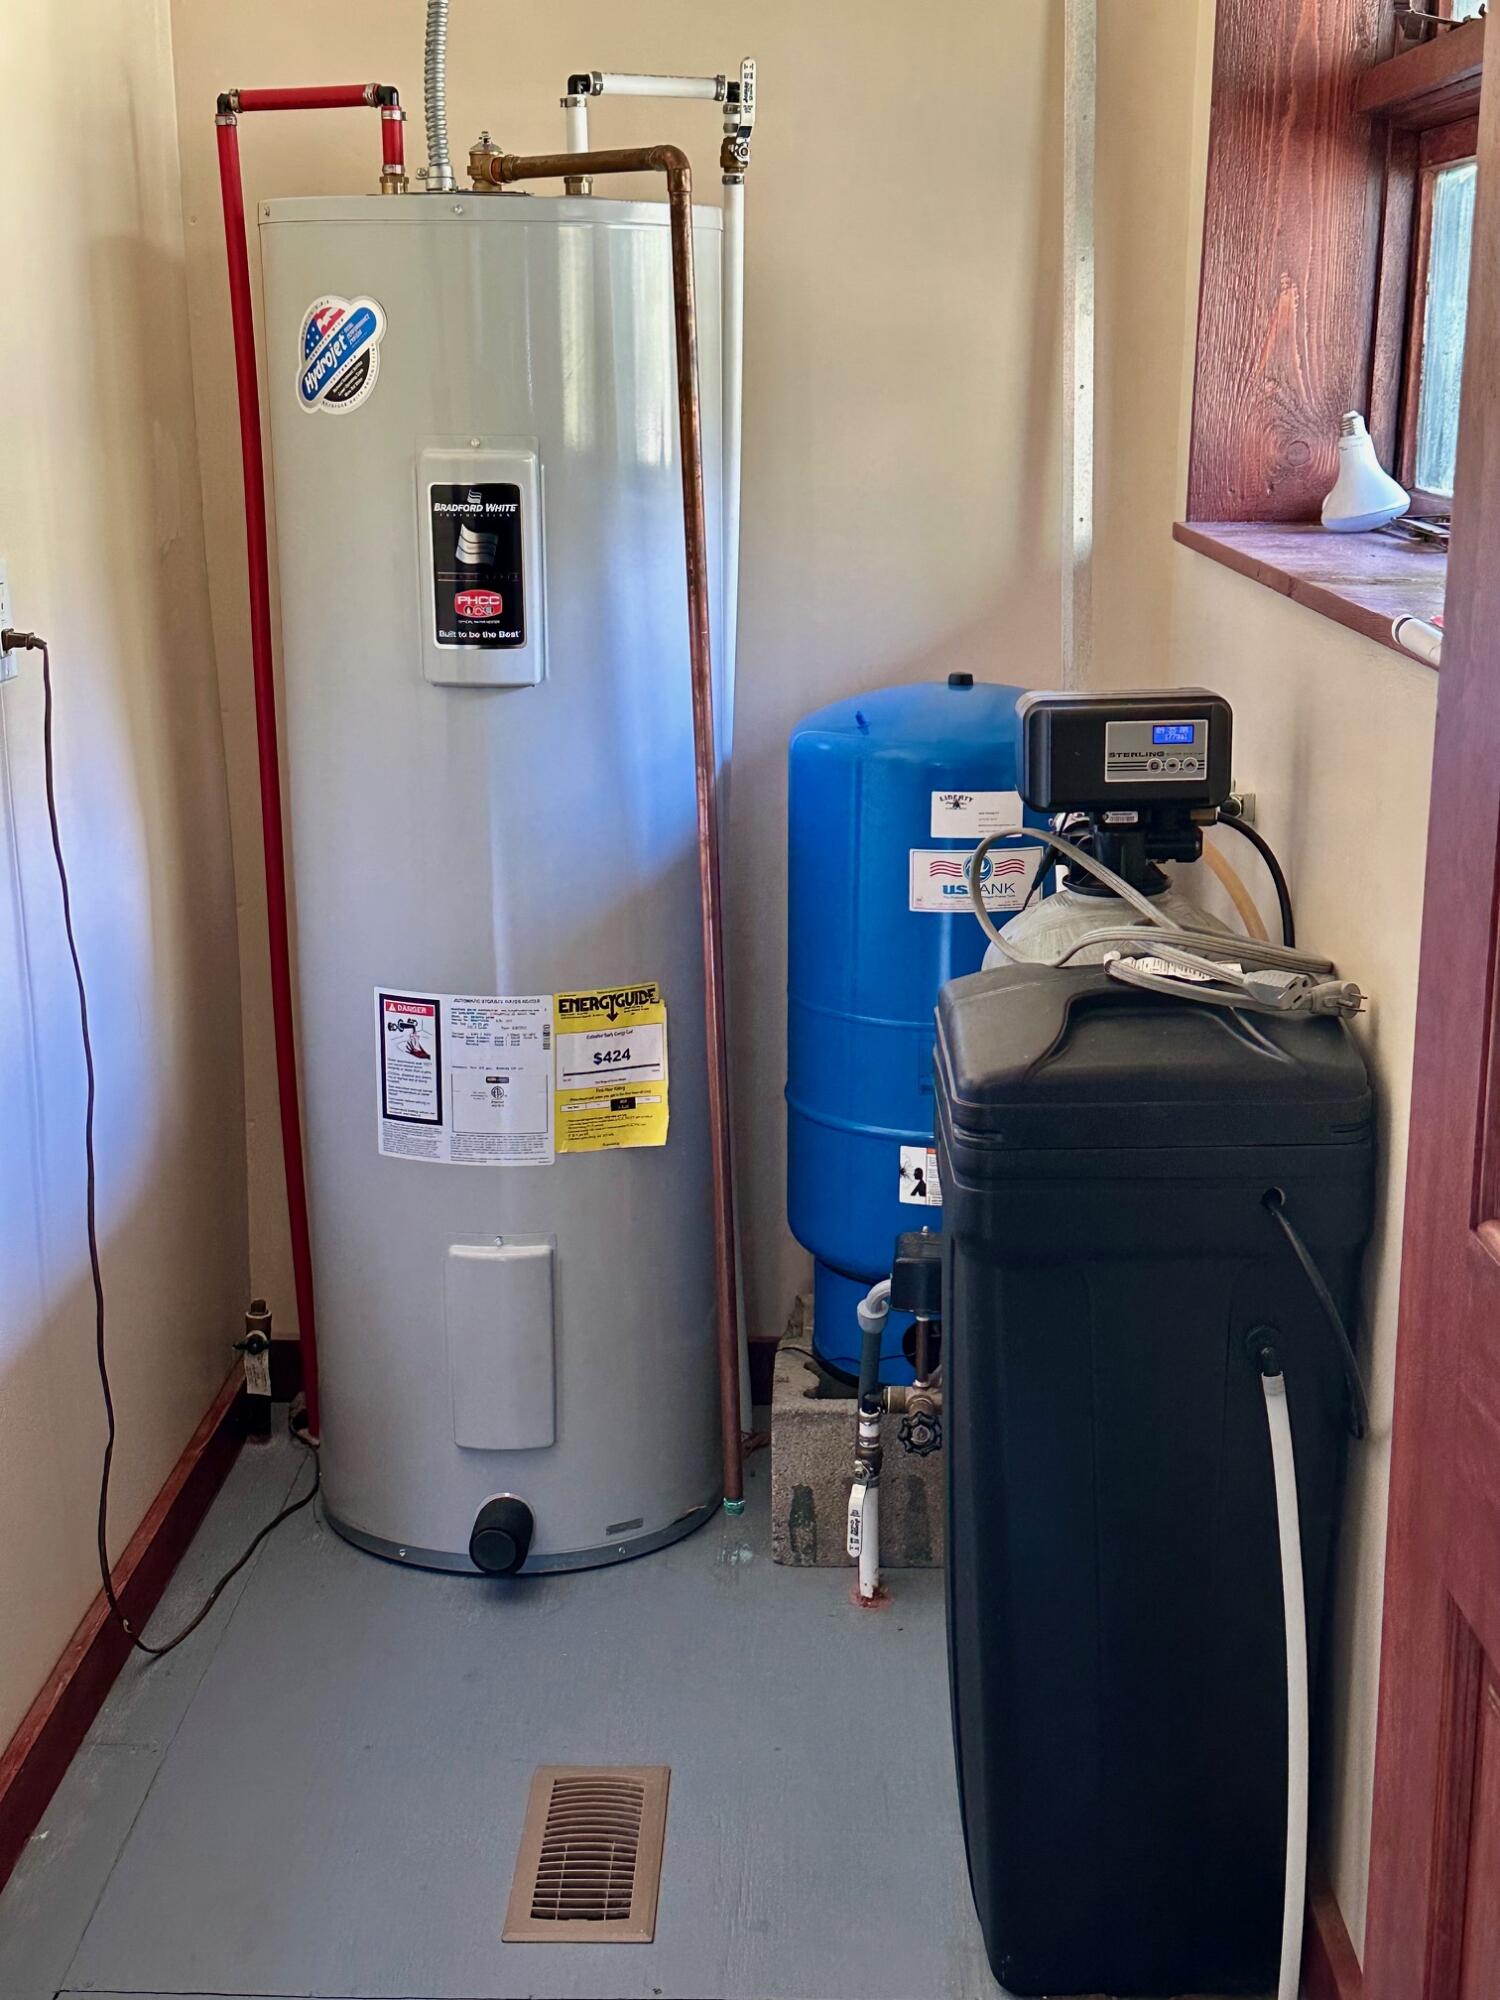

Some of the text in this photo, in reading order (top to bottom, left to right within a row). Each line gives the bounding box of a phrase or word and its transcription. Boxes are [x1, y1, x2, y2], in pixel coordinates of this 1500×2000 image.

[304, 333, 348, 394] Hydrojet
[433, 503, 519, 512] BRADFORD WHITE
[457, 595, 500, 605] PHCC
[438, 630, 457, 638] Built
[469, 630, 480, 638] be
[482, 630, 497, 638] the
[939, 794, 974, 802] LIBERTY
[558, 988, 660, 1014] ENERGYGUIDE
[397, 1003, 427, 1014] DANGER
[593, 1048, 631, 1065] $424
